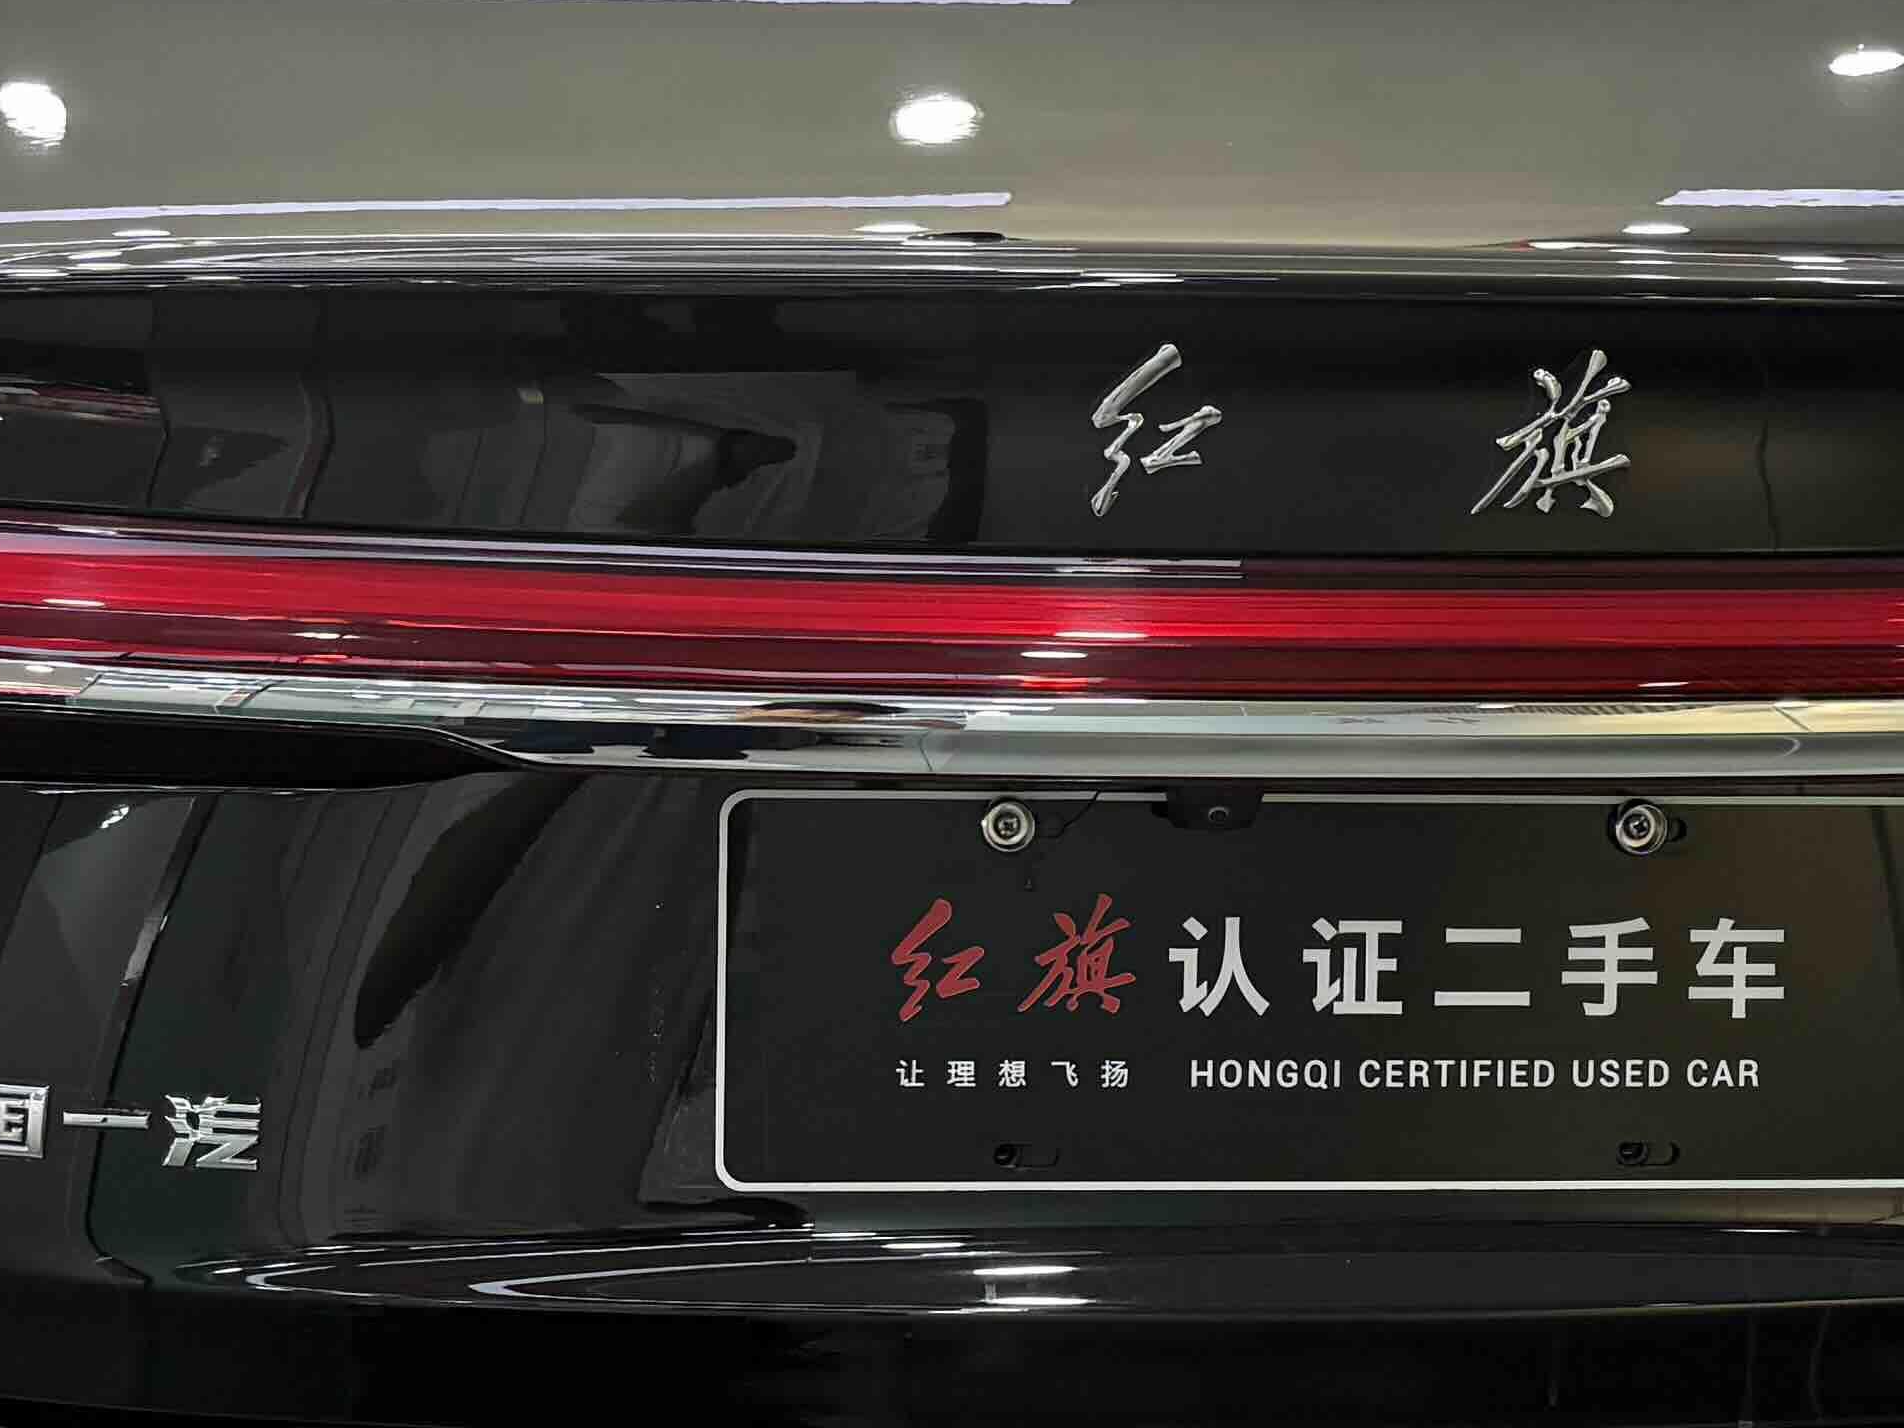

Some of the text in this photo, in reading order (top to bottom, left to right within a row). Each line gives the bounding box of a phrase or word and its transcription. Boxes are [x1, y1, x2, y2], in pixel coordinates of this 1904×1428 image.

[896, 1058, 1132, 1091] 让理想飞扬
[1190, 1059, 1761, 1092] HONGQI CERTIFIED USED CAR
